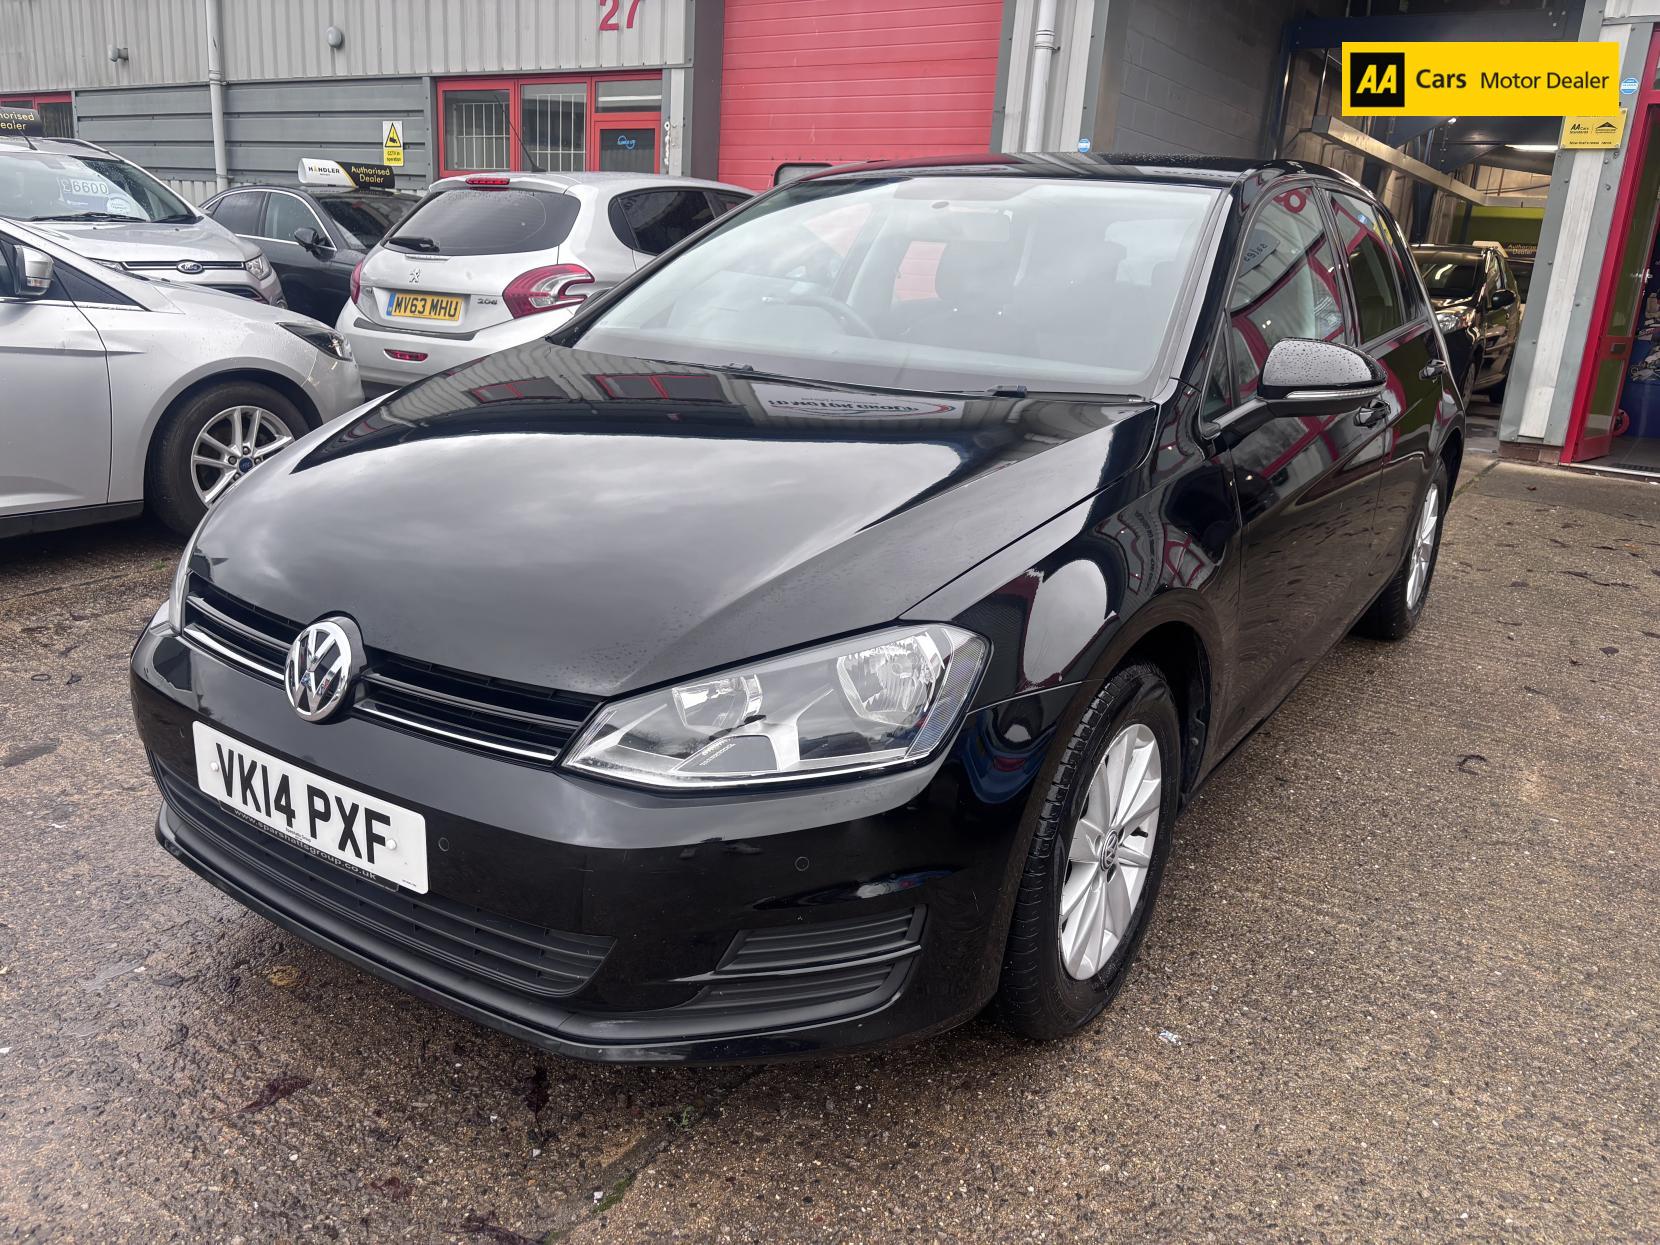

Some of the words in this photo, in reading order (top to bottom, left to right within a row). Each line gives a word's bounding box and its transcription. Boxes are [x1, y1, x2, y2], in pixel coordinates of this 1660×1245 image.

[599, 0, 640, 31] 27
[0, 111, 35, 121] orised
[0, 120, 27, 130] ealer
[352, 166, 390, 176] Authorised
[360, 174, 384, 183] Dealer
[394, 296, 427, 314] MV63
[428, 299, 459, 318] MHU
[216, 742, 296, 828] VK14
[306, 783, 390, 865] PXF
